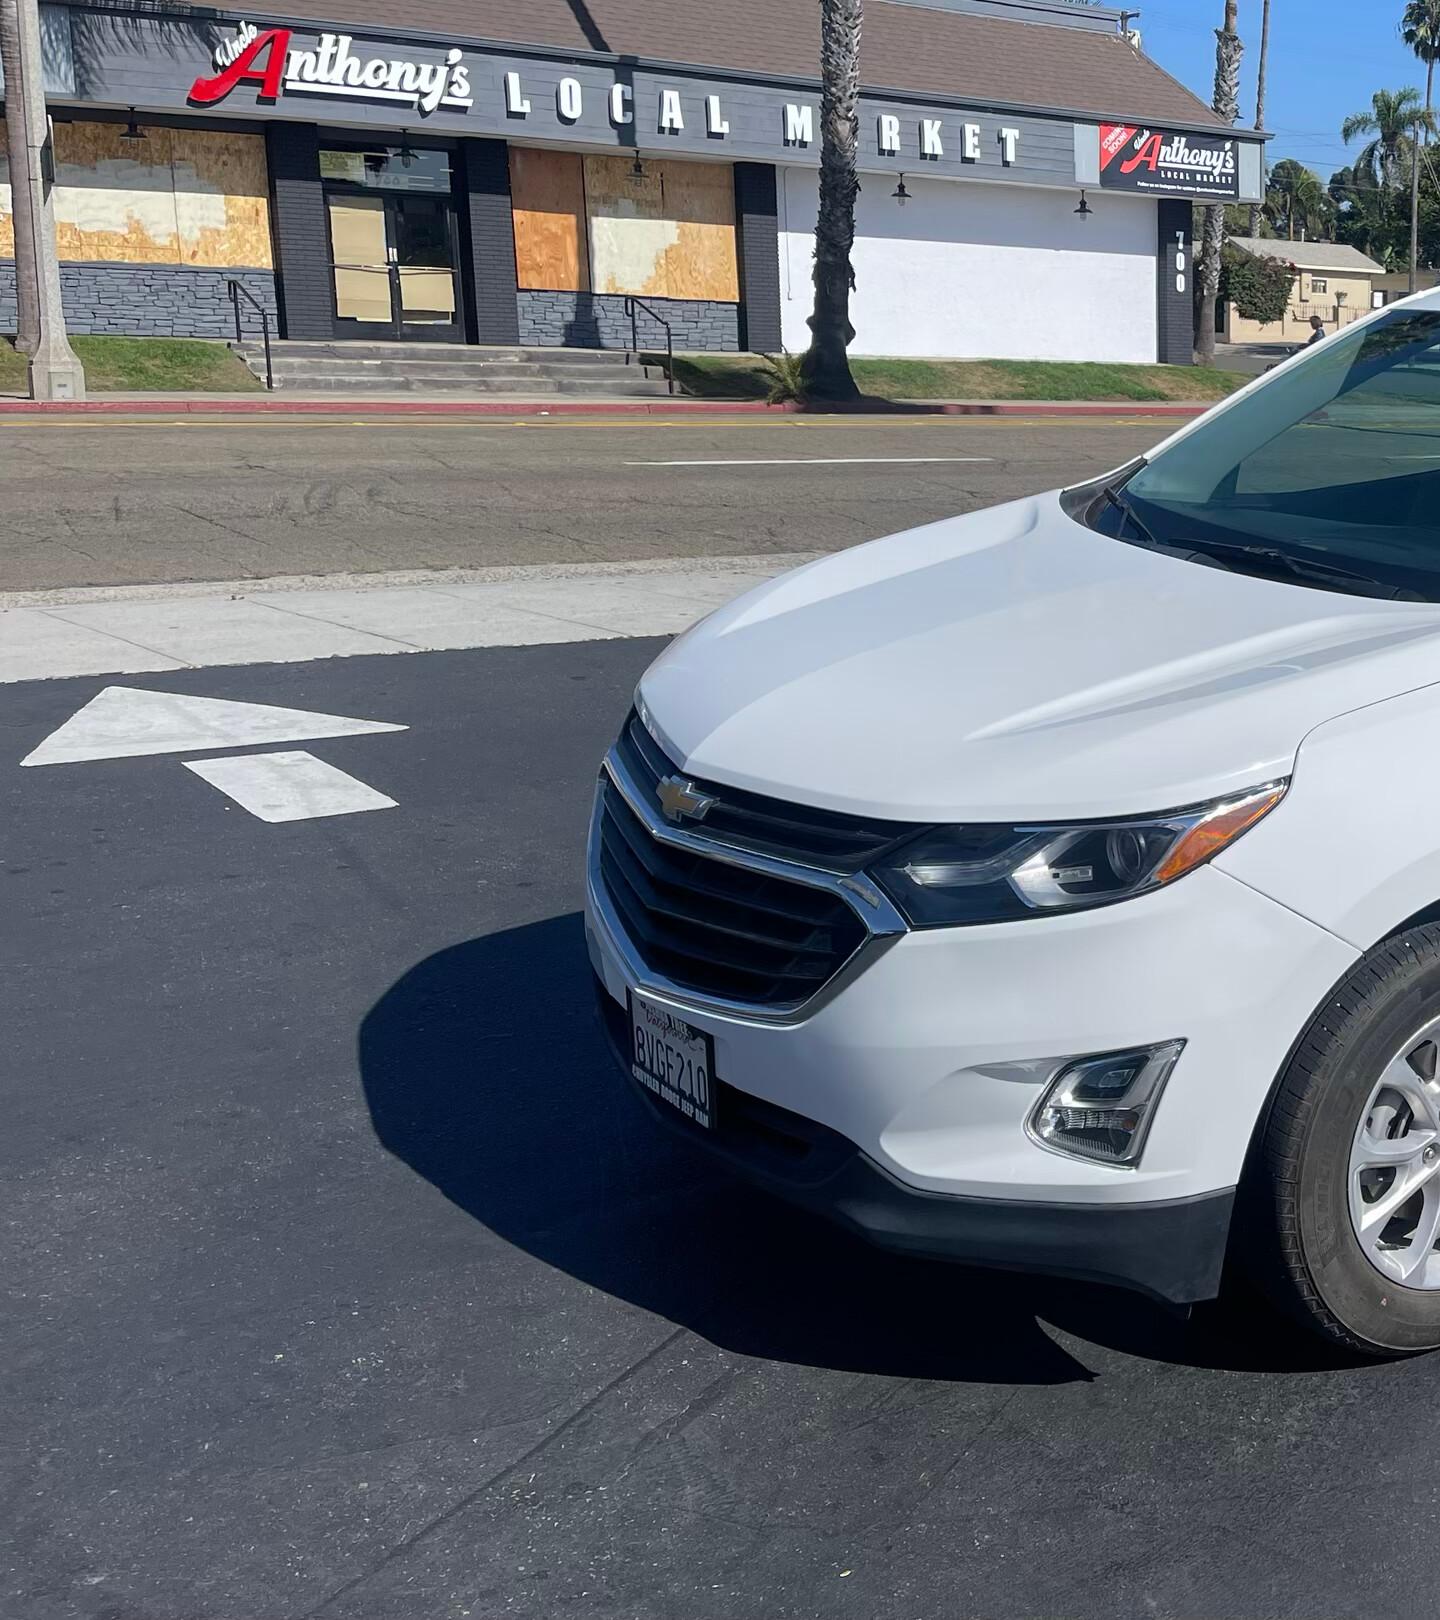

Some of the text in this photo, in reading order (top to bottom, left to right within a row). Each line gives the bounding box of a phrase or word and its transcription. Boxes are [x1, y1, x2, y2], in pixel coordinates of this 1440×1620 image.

[215, 20, 258, 67] Uncle
[186, 28, 471, 112] Anthony's
[506, 71, 1019, 162] LOCAL MRKET
[1107, 131, 1128, 154] SOON!
[1120, 133, 1234, 176] Anthony's
[1160, 170, 1233, 184] LOCAL MARKET
[1175, 230, 1185, 292] 700
[635, 1025, 707, 1108] 8VGF210
[681, 1098, 694, 1118] JEEP
